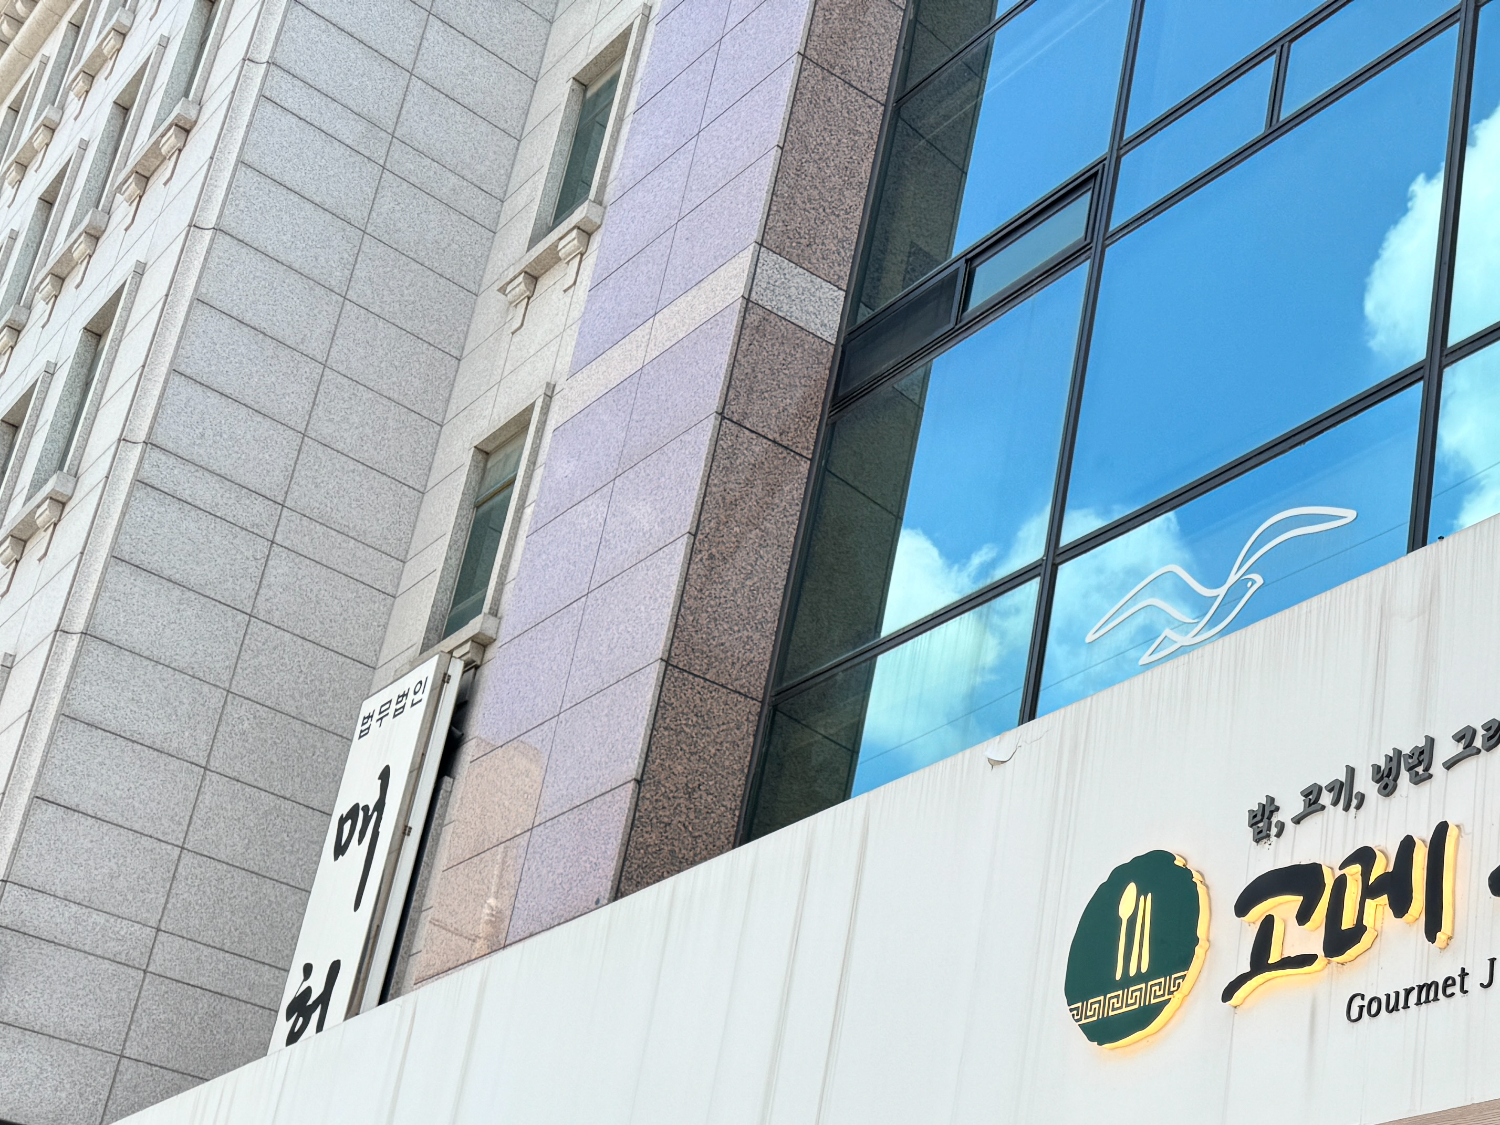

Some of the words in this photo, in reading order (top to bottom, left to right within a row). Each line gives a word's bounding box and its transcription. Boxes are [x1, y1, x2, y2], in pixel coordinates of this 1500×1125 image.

[357, 676, 429, 741] 법무법인
[1248, 794, 1286, 844] 밥,
[1290, 765, 1365, 826] 고기,
[1371, 735, 1435, 798] 냉면
[1220, 820, 1458, 1007] 고메
[1344, 966, 1470, 1024] Gourmet
